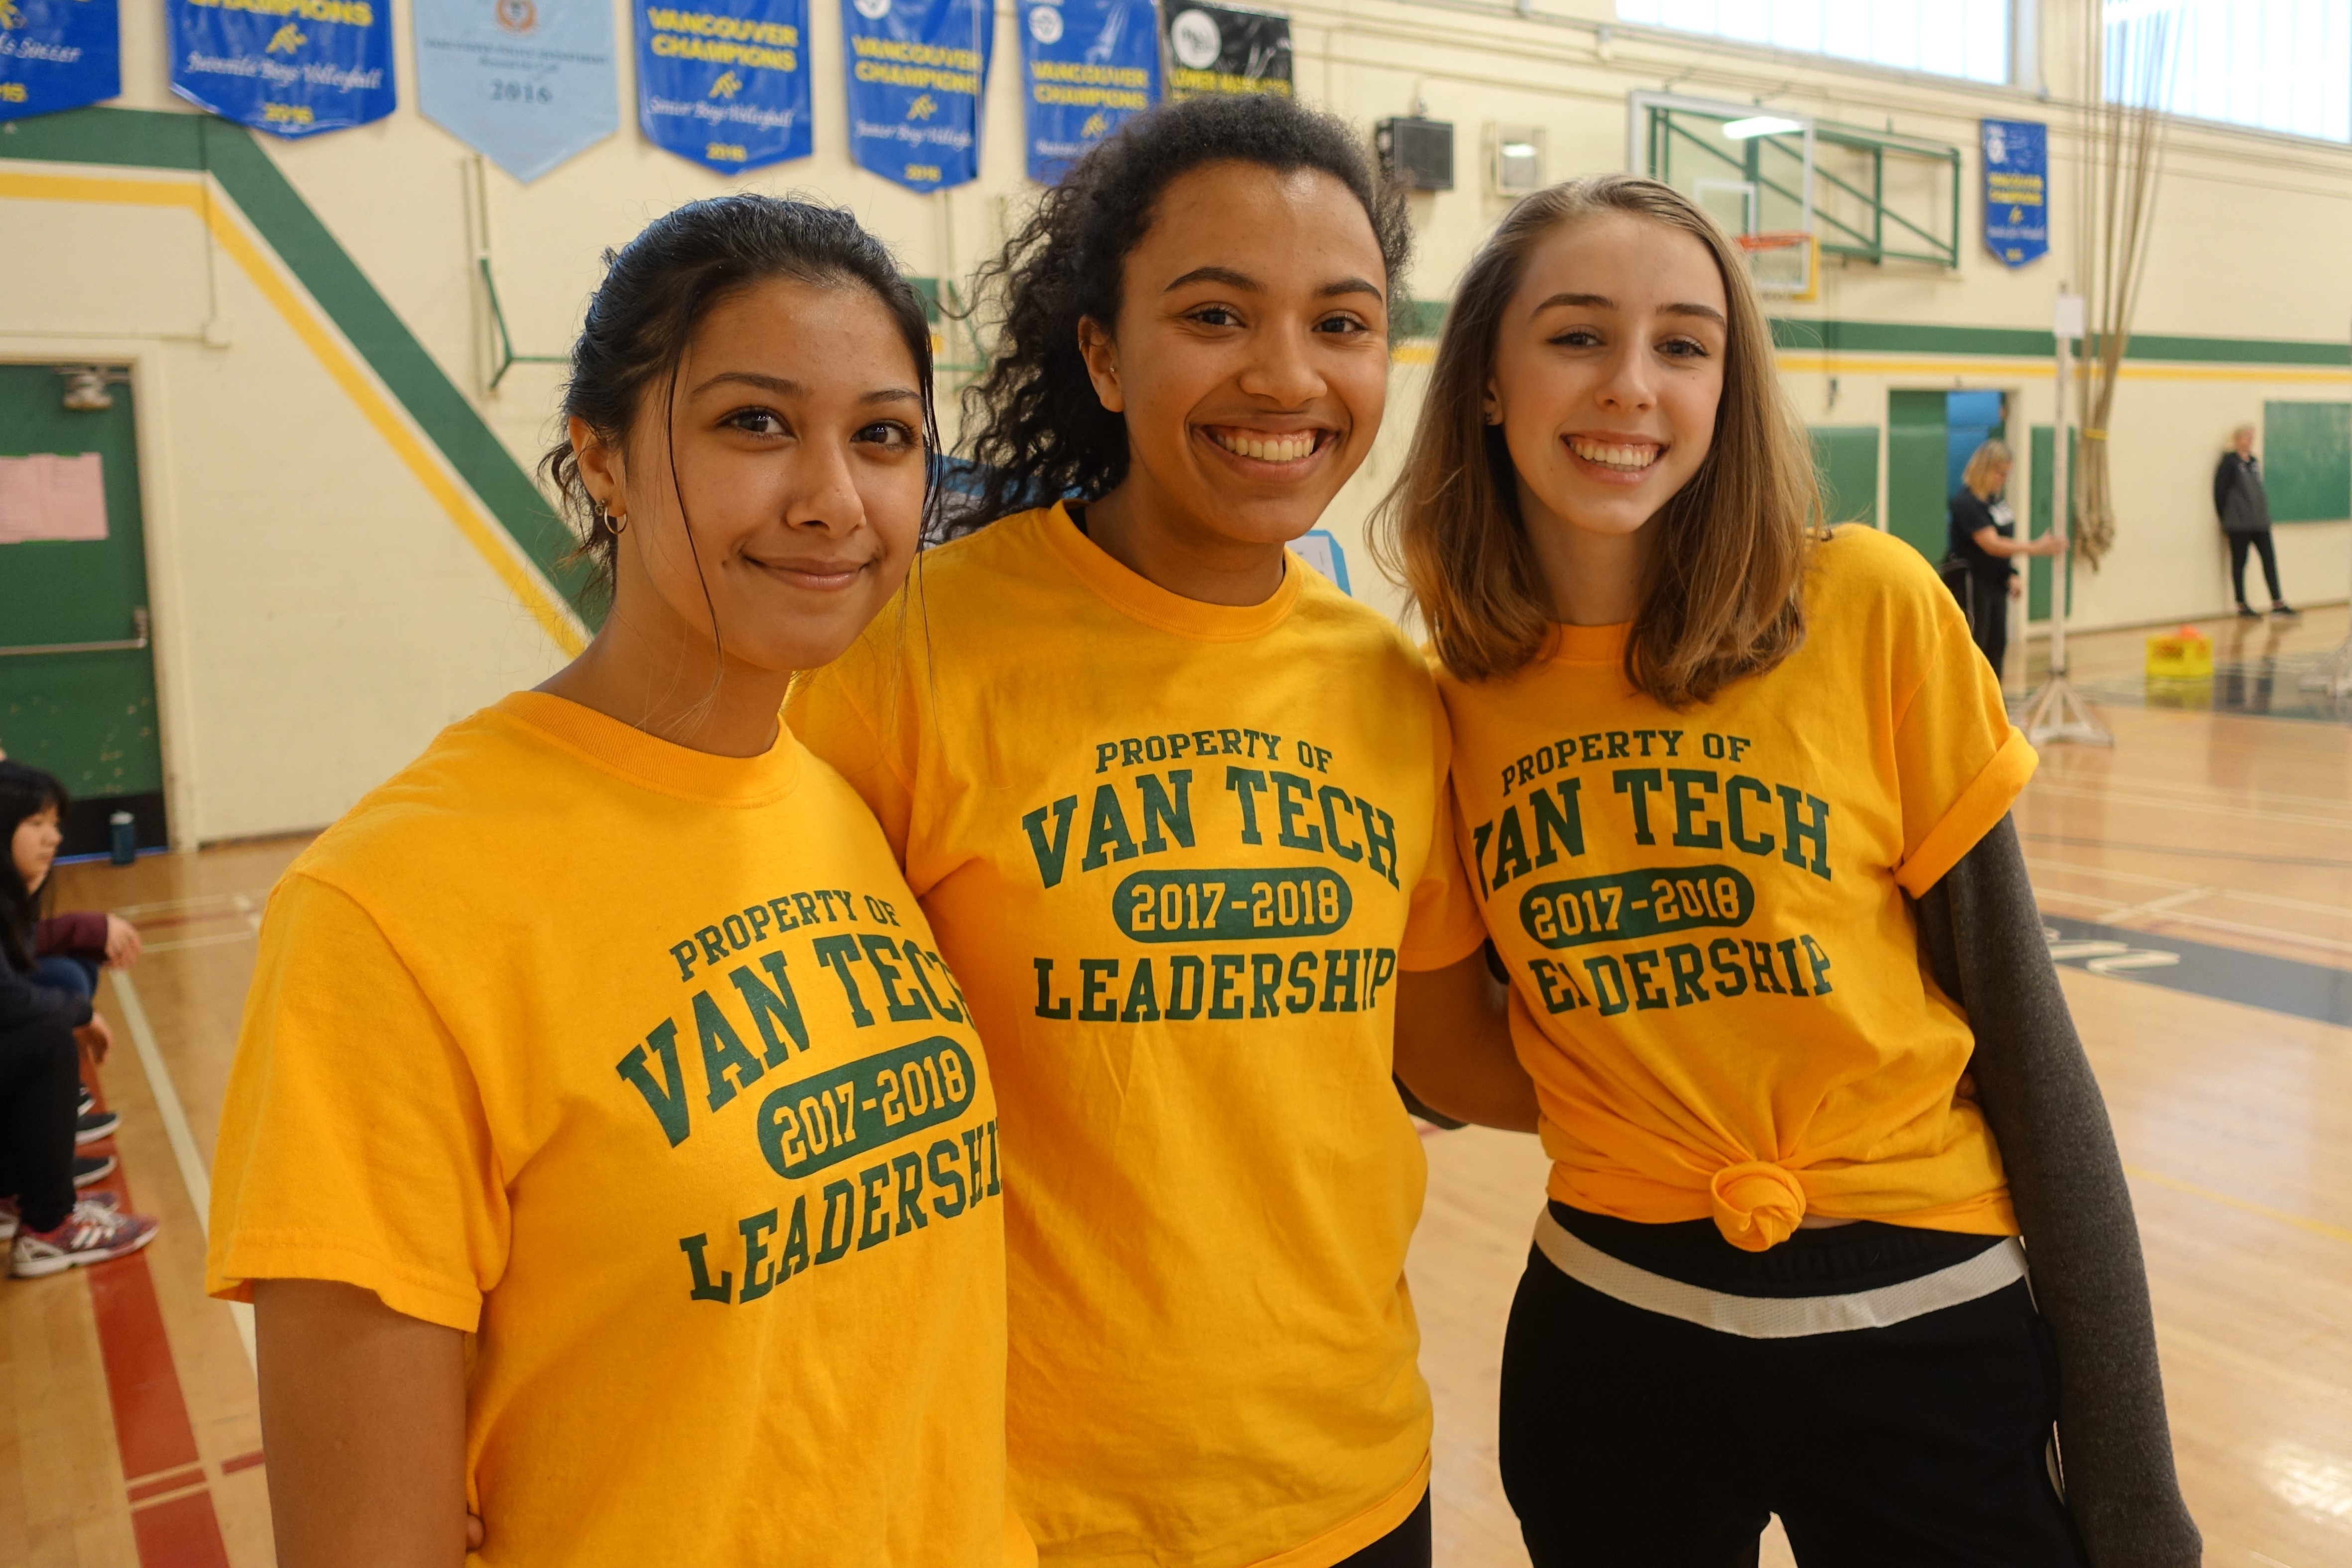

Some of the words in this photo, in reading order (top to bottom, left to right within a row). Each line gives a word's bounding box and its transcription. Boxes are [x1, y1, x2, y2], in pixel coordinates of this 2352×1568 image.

[647, 6, 798, 47] VANCOUVER
[651, 33, 797, 72] CHAMPIONS
[851, 34, 983, 72] VANCOUVER
[0, 82, 28, 103] 15
[490, 78, 553, 104] 2016
[855, 60, 981, 95] CHAMPIONS
[1029, 59, 1148, 88] VANCOUVER
[1033, 84, 1148, 111] CHAMPIONS
[1096, 728, 1281, 774] PROPERTY
[1297, 740, 1332, 773] OF
[1501, 730, 1684, 797] PROPERTY
[1703, 733, 1750, 762] OF
[1022, 769, 1195, 889] VAN
[1226, 765, 1400, 892] TECH
[1612, 768, 1832, 882] TECH
[1131, 879, 1340, 932] 2017-2018
[1530, 877, 1739, 941] 2017-2018
[669, 890, 858, 983] PROPERTY
[863, 895, 901, 927] OF
[1033, 948, 1396, 1023] LEADERSHIP
[616, 951, 810, 1148] VAN
[773, 1049, 968, 1168] 2017-2018
[679, 1116, 1002, 1305] LEADERSHI
